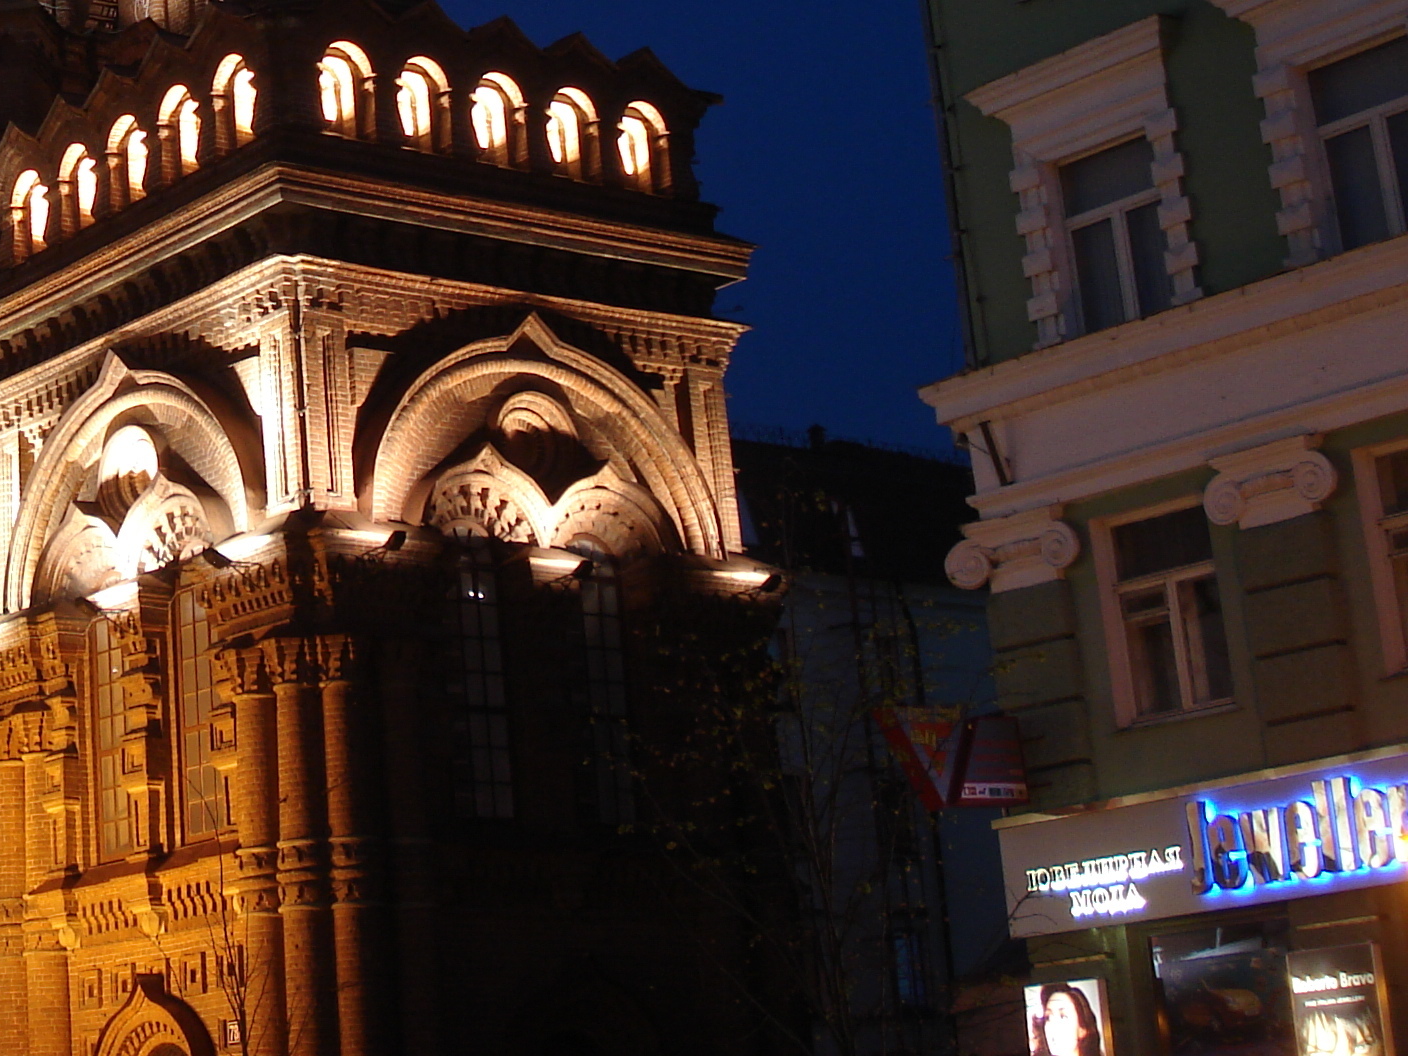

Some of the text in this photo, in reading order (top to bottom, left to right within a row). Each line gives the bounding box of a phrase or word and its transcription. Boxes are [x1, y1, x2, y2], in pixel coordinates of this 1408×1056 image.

[1025, 845, 1184, 892] ЮВЕЛИРНАЯ
[1069, 882, 1147, 918] МОДА
[1338, 971, 1375, 989] Bravo
